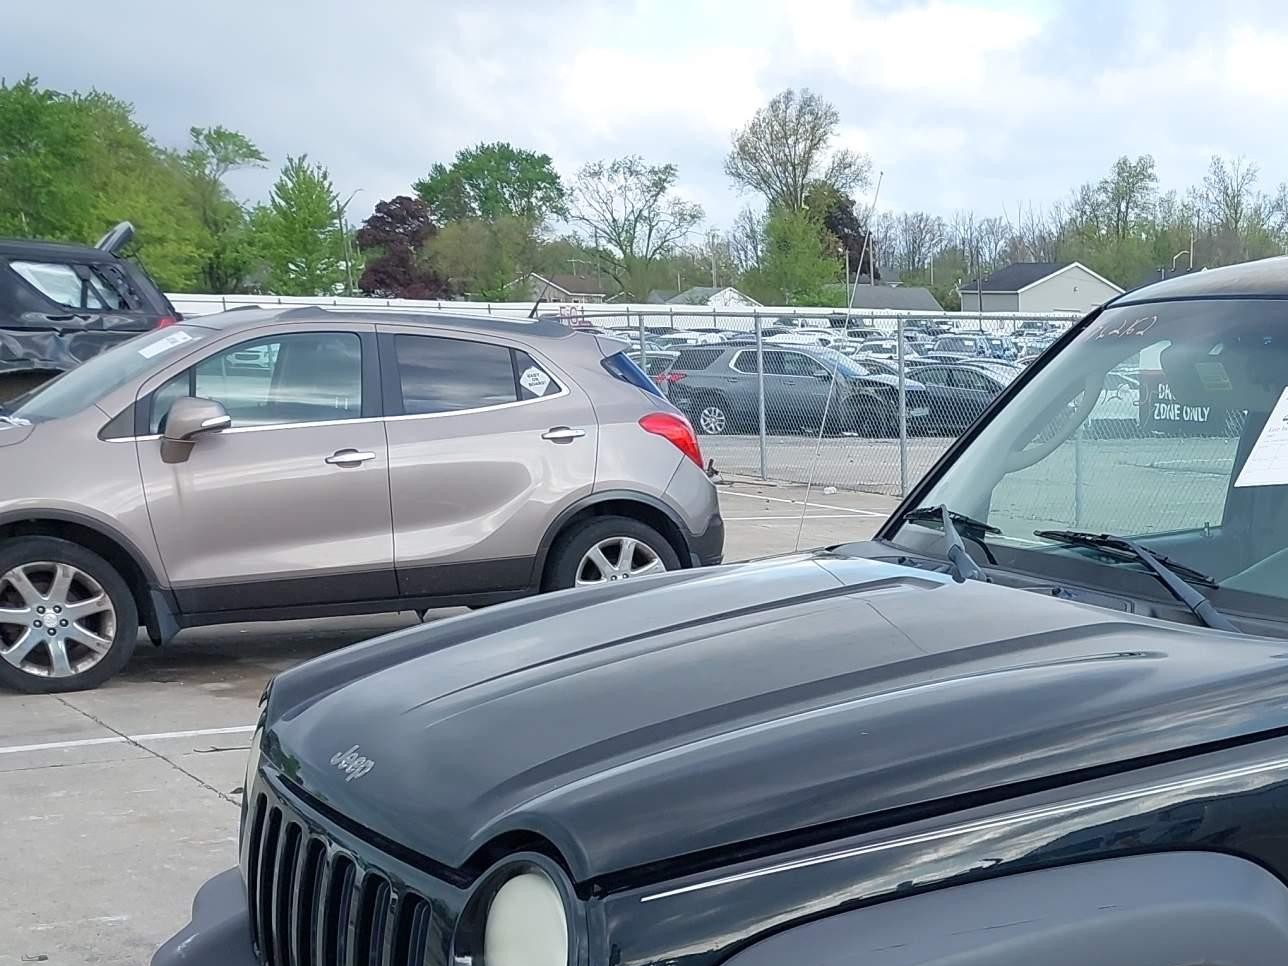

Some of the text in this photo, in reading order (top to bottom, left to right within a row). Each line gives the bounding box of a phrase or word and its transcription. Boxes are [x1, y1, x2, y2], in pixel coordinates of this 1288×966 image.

[1153, 403, 1210, 422] ZONE ONLY
[330, 744, 375, 782] Jeep
